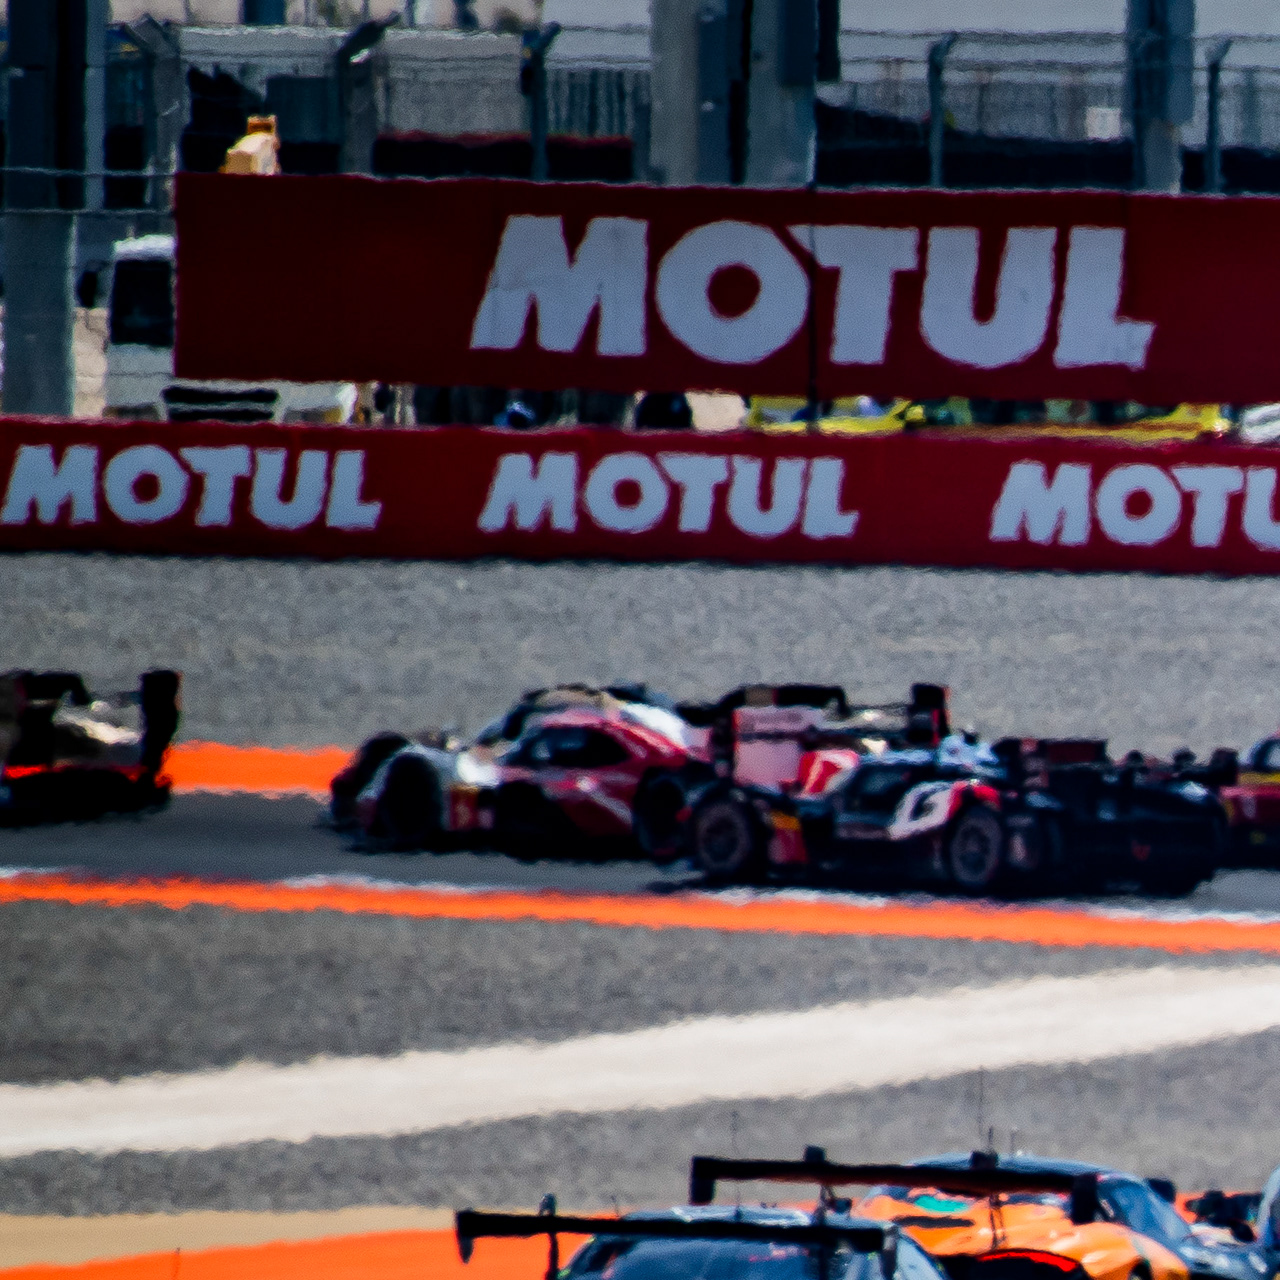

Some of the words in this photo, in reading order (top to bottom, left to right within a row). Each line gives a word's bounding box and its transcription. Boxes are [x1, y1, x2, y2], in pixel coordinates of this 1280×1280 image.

[471, 216, 1154, 368] MOTUL
[2, 445, 381, 528] MOTUL
[479, 453, 858, 538] MOTUL
